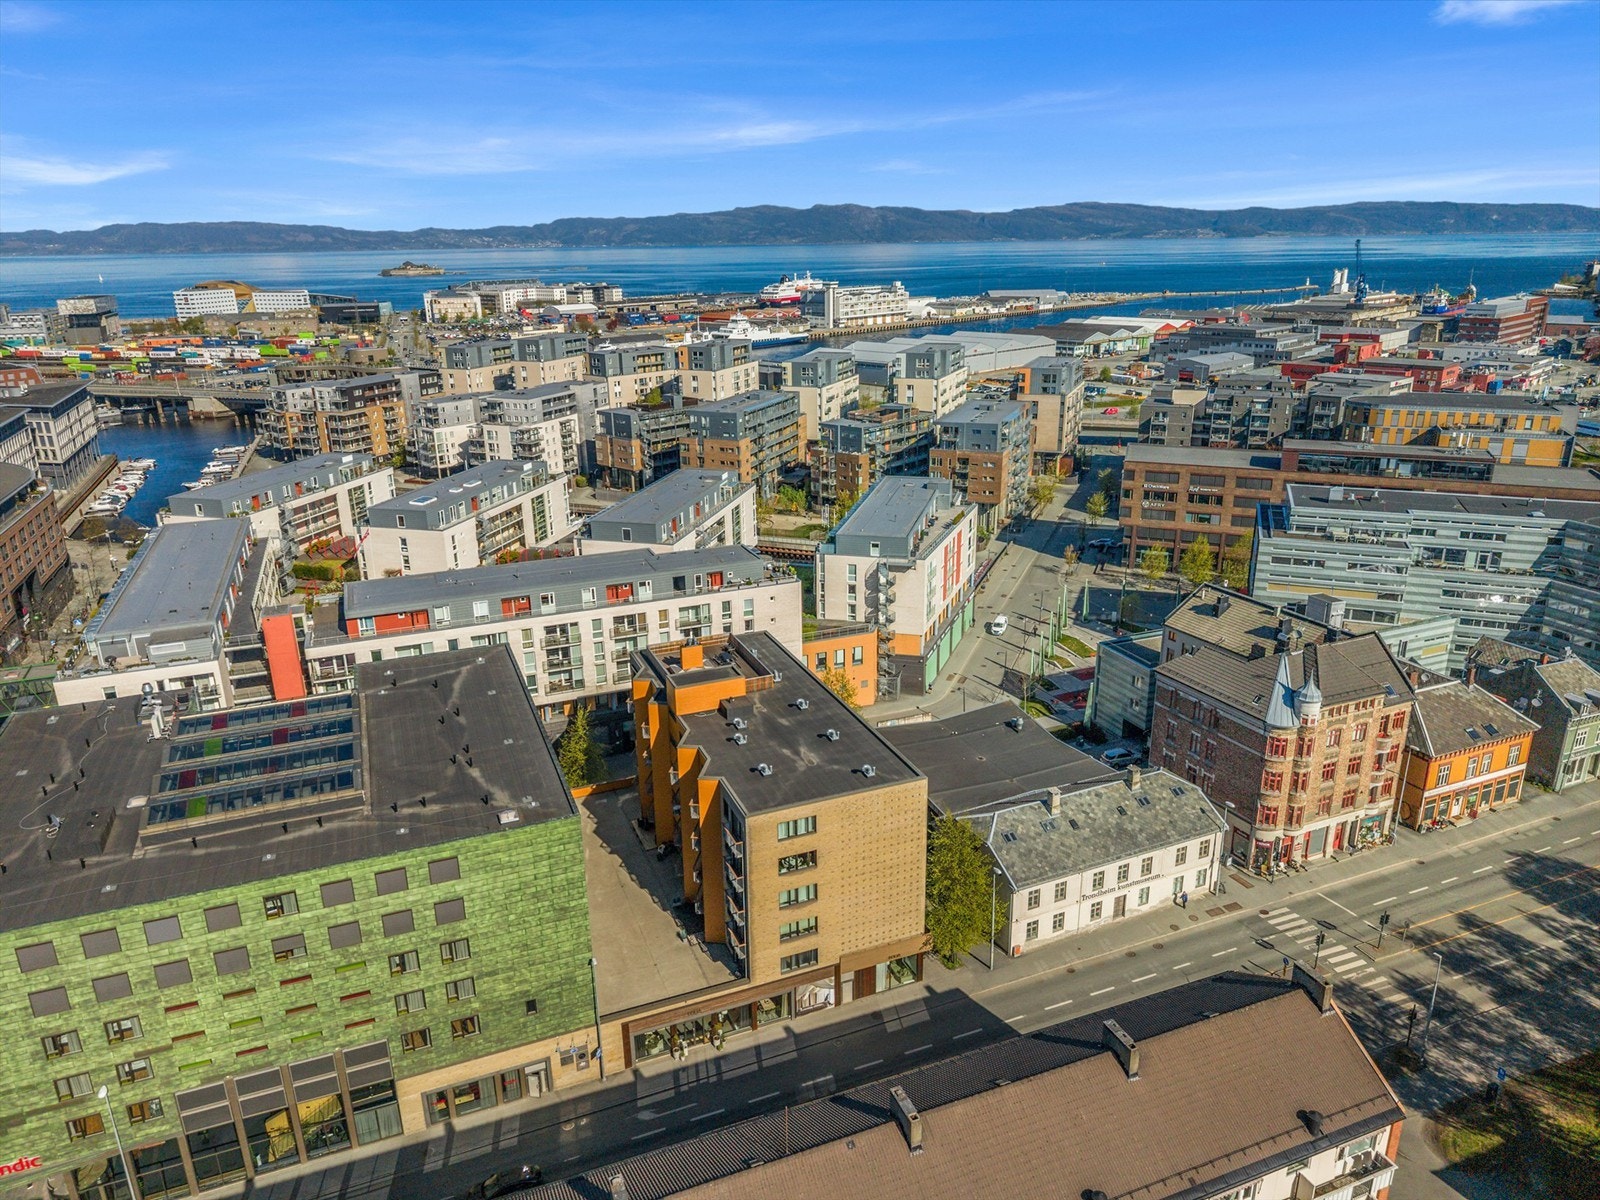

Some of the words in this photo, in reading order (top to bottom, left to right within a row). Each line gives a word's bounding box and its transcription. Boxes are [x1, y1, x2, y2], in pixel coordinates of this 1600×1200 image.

[1081, 887, 1116, 902] Trondheim
[1117, 873, 1161, 891] kunstmuseum
[0, 1156, 43, 1176] ndic
